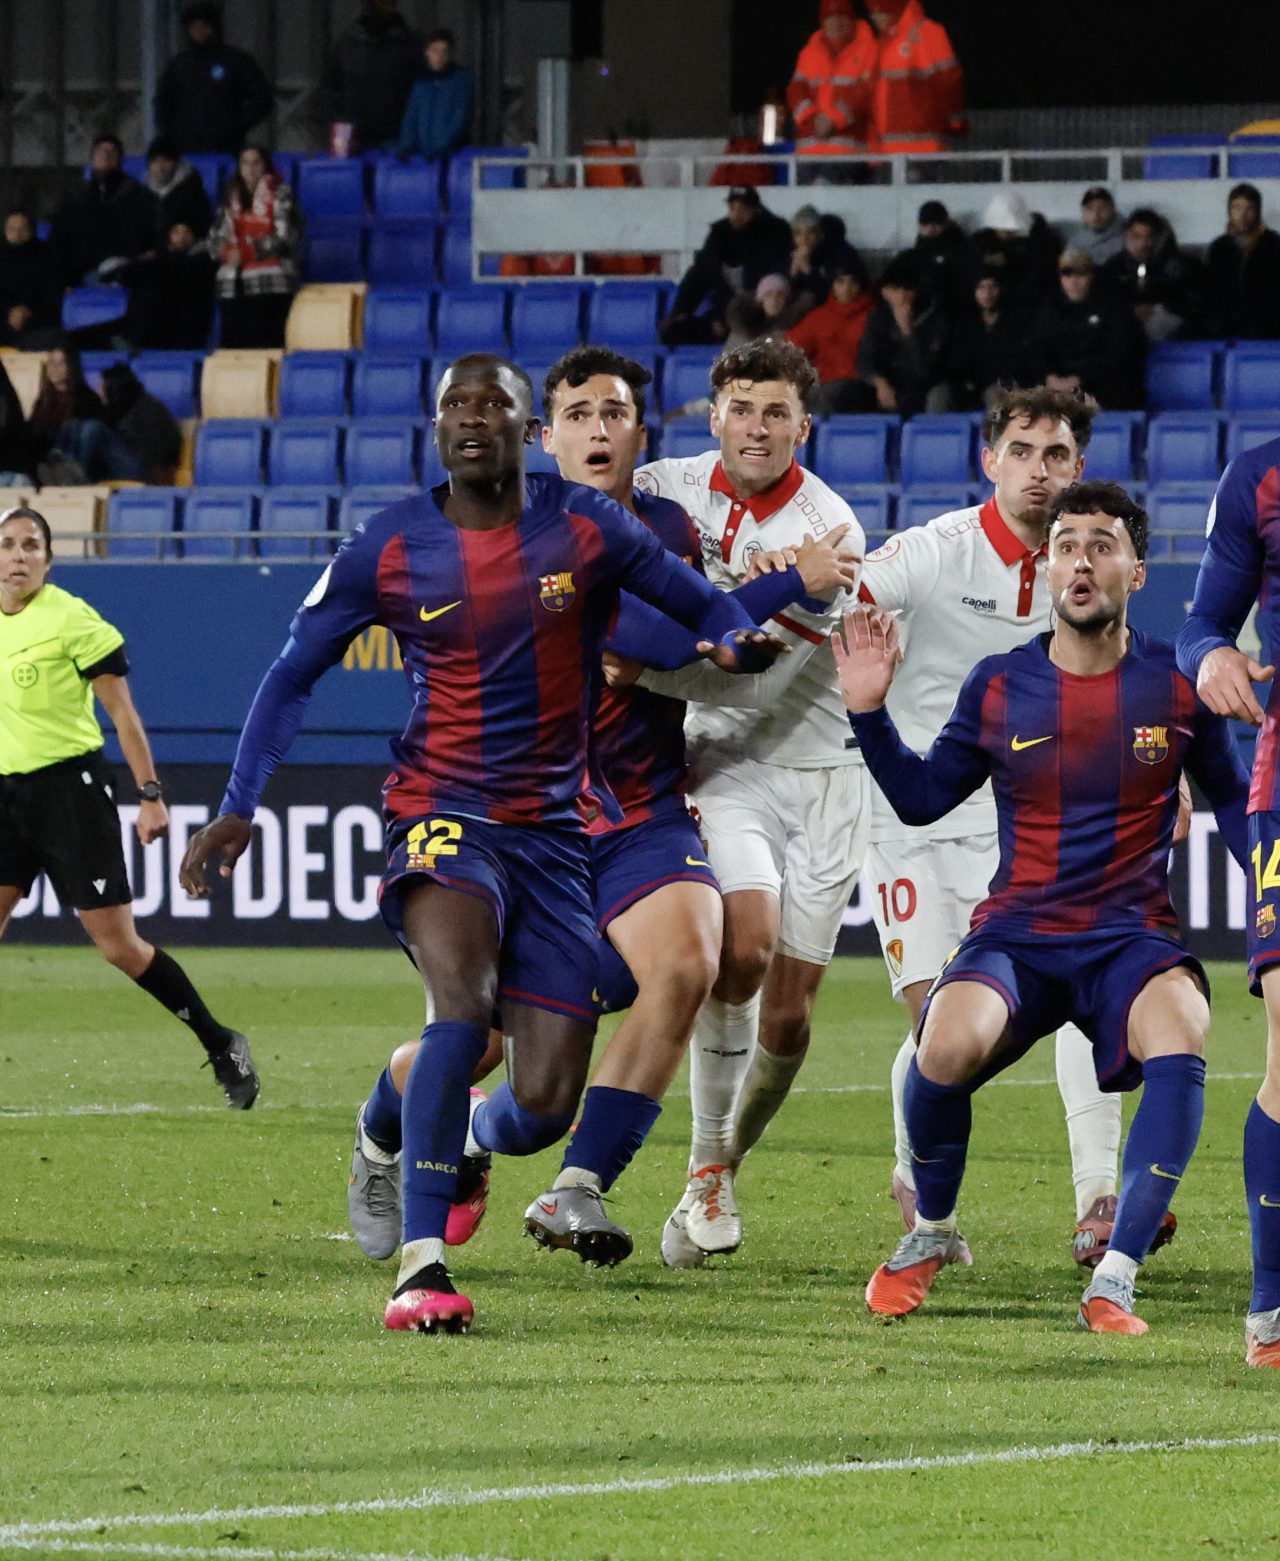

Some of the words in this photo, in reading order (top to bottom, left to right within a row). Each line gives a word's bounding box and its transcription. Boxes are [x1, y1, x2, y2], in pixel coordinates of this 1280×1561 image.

[961, 597, 996, 611] capelli
[406, 818, 463, 856] 12
[878, 877, 917, 927] 10
